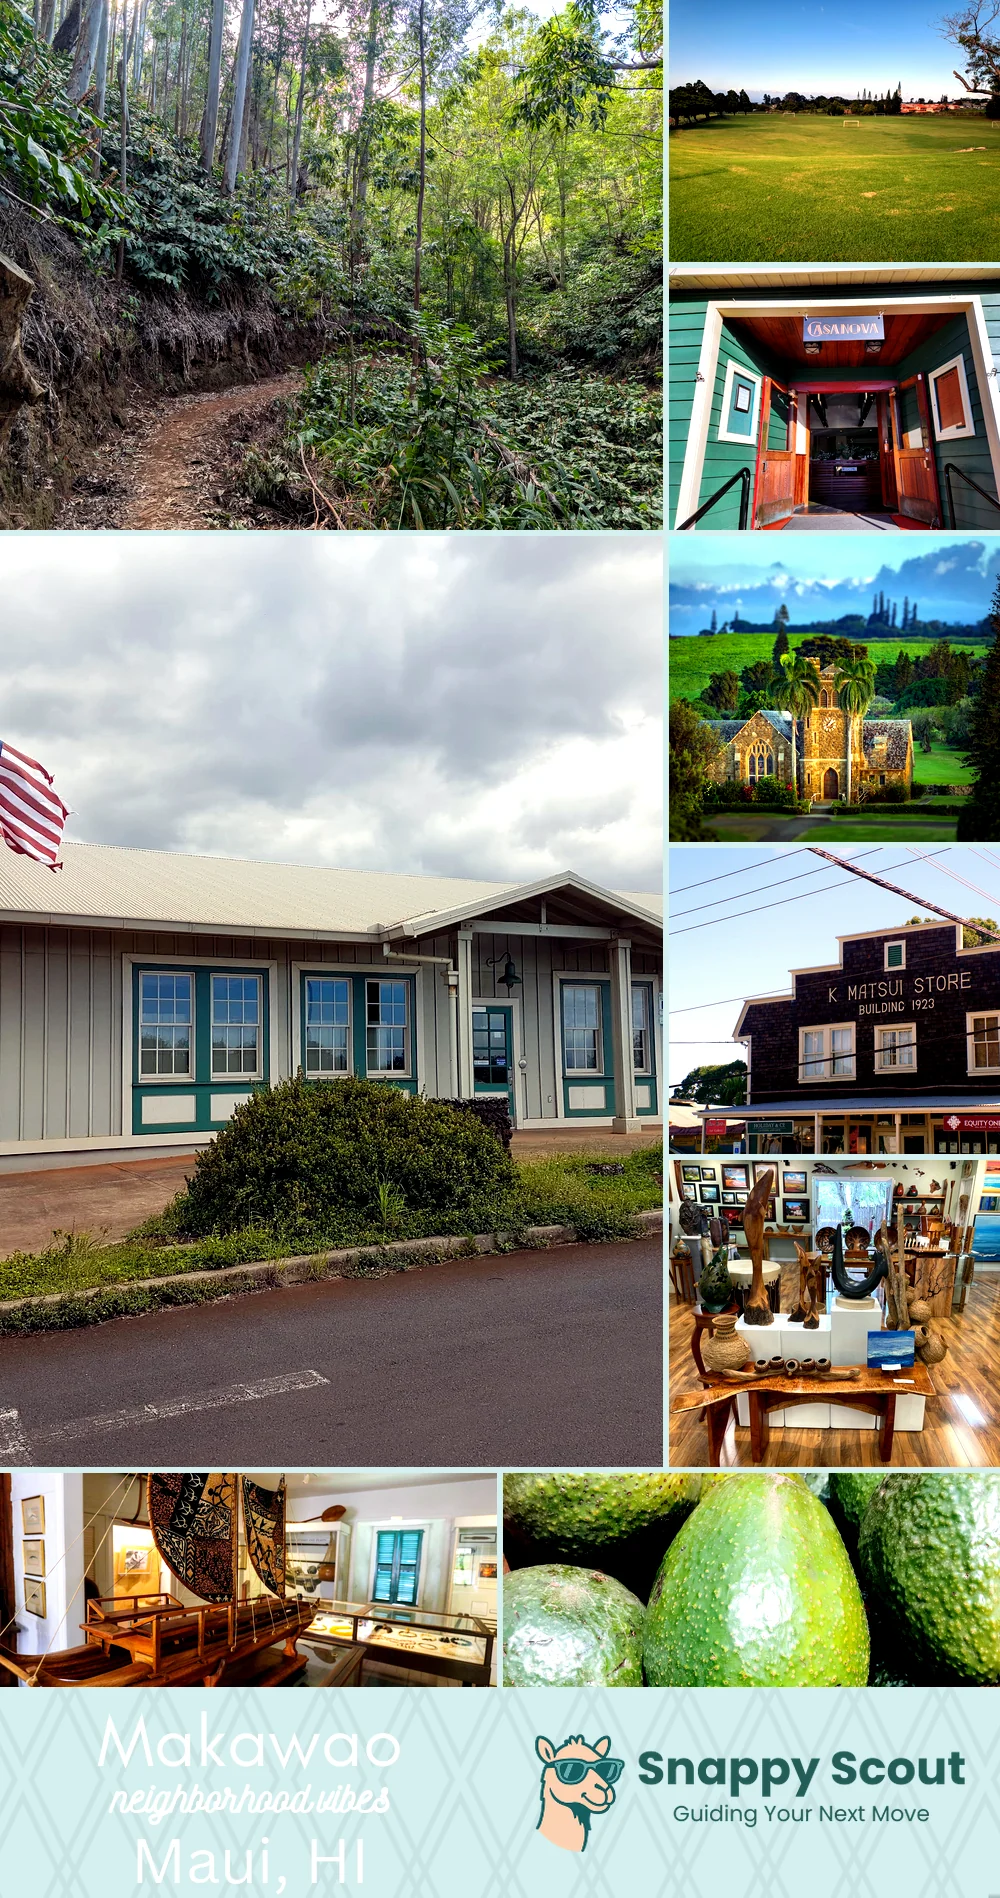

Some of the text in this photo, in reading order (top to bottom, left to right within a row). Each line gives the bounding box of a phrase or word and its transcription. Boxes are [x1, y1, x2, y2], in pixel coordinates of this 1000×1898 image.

[807, 321, 879, 337] CASANOVA
[828, 971, 972, 1003] K MATSUI STORE
[858, 998, 935, 1016] BUILDING 1923
[964, 1119, 989, 1127] EQUITY
